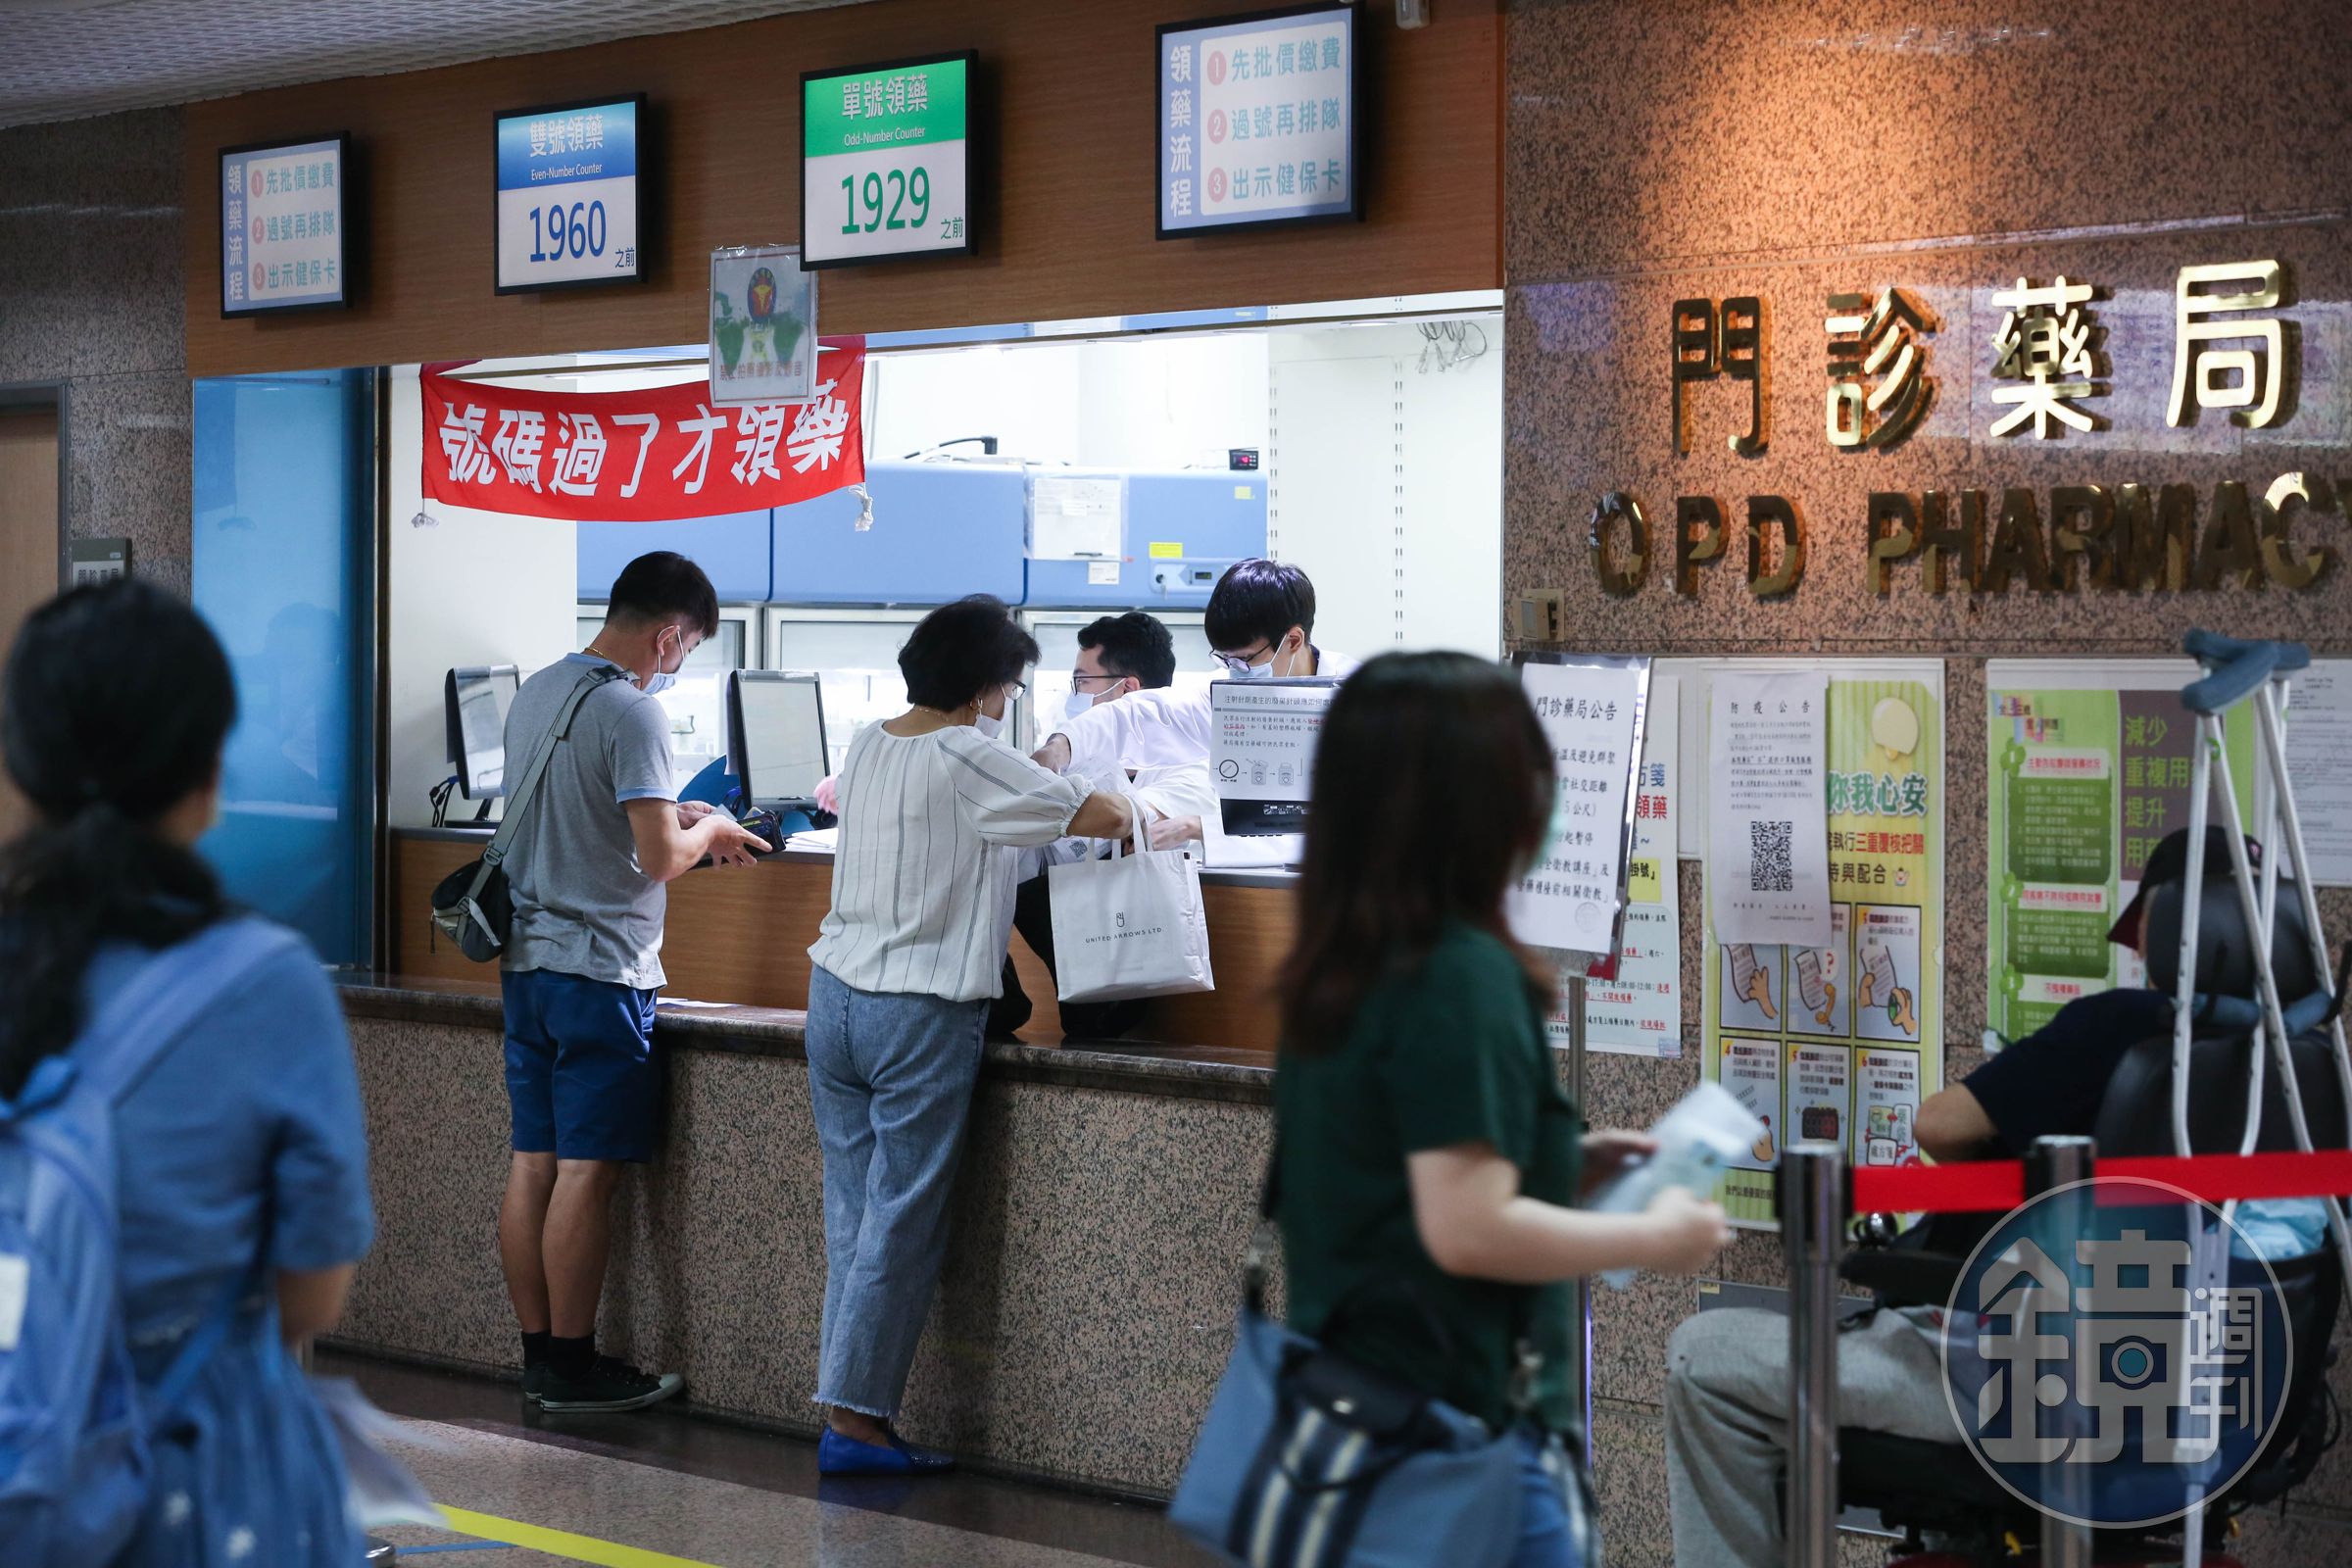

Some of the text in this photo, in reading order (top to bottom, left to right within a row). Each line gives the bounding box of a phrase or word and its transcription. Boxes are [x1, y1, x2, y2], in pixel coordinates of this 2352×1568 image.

[1231, 36, 1341, 83] 先批價繳費
[842, 73, 929, 121] 單號領藥
[529, 112, 604, 160] 雙號領藥
[844, 126, 926, 146] Odd-Number Counter
[1170, 44, 1193, 218] 領藥流程
[1231, 97, 1342, 142] 過號再排隊
[266, 163, 335, 195] 先批價繳費
[530, 161, 603, 181] Even-Number Counter
[1232, 158, 1342, 200] 出示健保卡
[842, 166, 931, 235] 1929
[227, 164, 244, 301] 領藥流程
[267, 210, 335, 244] 過號再排隊
[529, 199, 608, 264] 1960
[940, 217, 964, 240] 之前
[268, 258, 335, 290] 出示健保卡
[614, 247, 636, 270] 之前
[1671, 259, 2285, 455] 門診藥局
[438, 378, 850, 498] 號碼過了才領藥
[1589, 492, 1805, 600] OPD
[1534, 696, 1618, 721] 門診藥局公告
[1730, 700, 1811, 715] 防疫公告
[2125, 714, 2168, 747] 減少
[2125, 757, 2194, 789] 重複用
[1637, 795, 1668, 819] 領藥
[2125, 797, 2168, 828] 提升
[1085, 935, 1111, 944] UNITED
[1113, 929, 1147, 940] ARROWS
